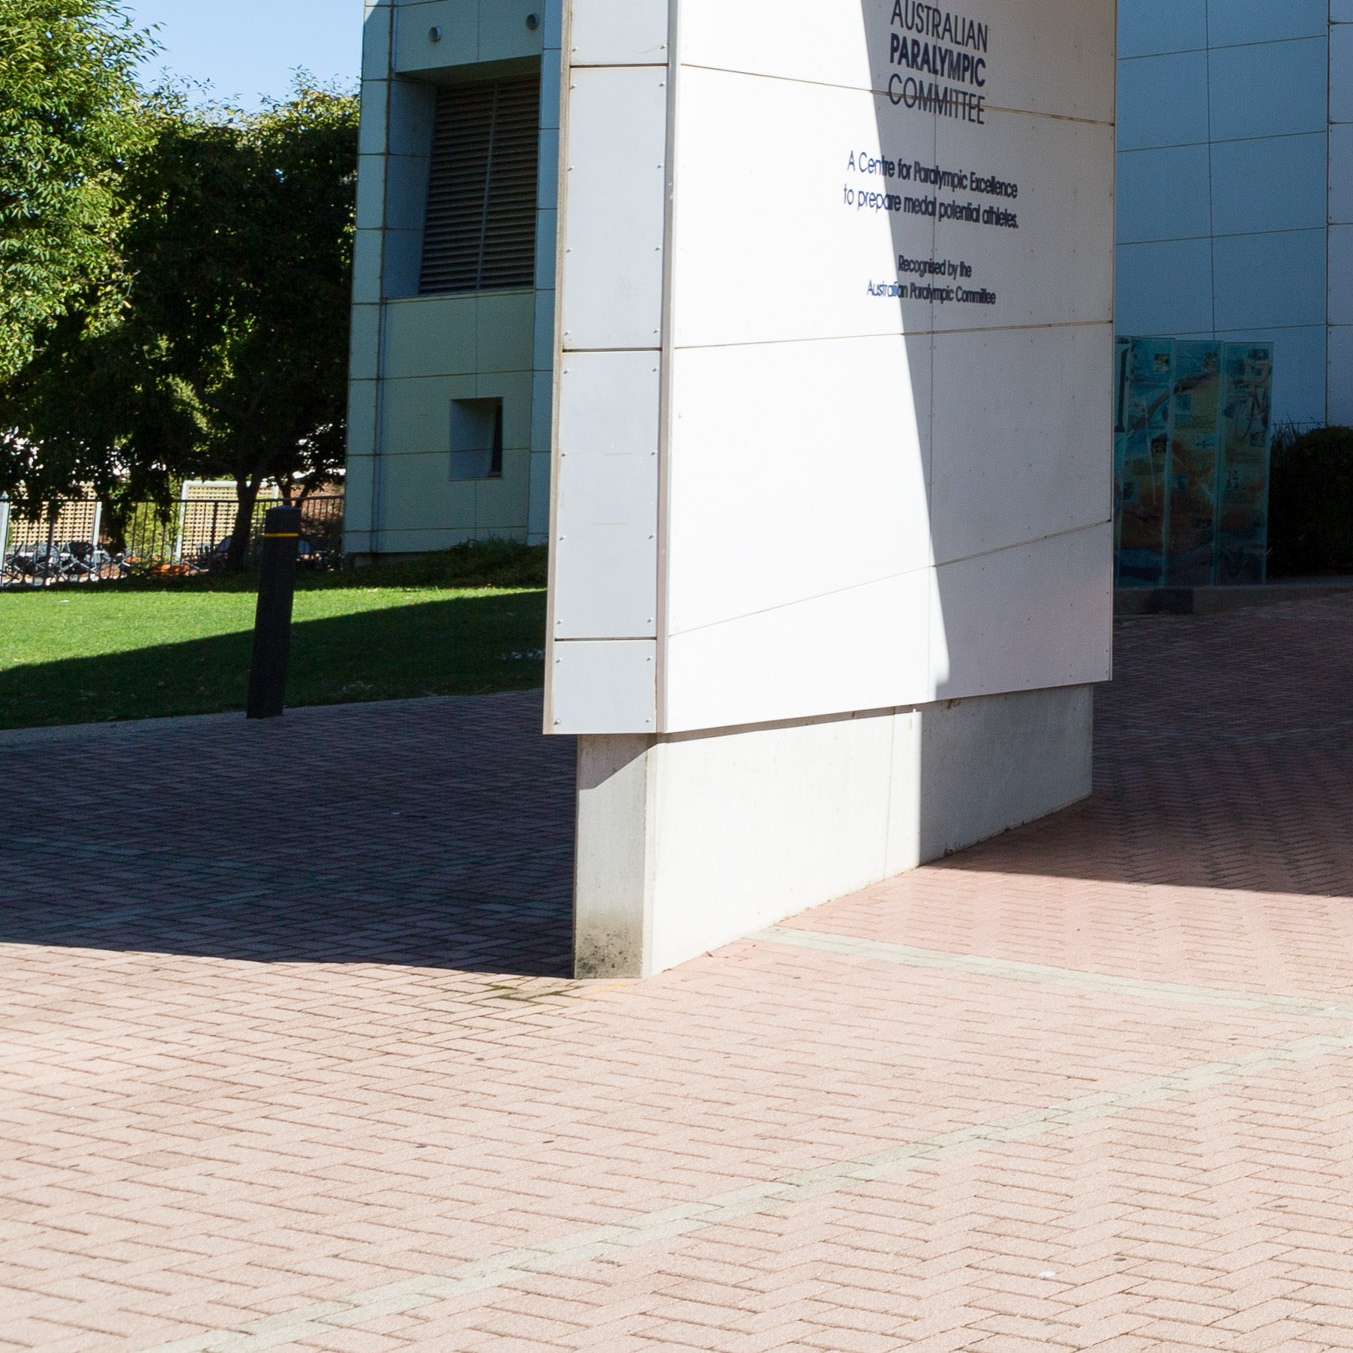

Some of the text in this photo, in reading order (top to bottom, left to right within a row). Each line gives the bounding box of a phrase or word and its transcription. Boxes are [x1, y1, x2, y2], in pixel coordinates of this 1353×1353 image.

[890, 32, 987, 88] PARALYMPIC
[888, 73, 986, 125] COMMITTEE
[847, 150, 1018, 199] A Centre for Paralympic Excellence
[844, 183, 1019, 230] to prepare medal potential athletes.
[898, 254, 973, 280] Recognised by the
[866, 279, 997, 305] Australian Paralympic Committee
